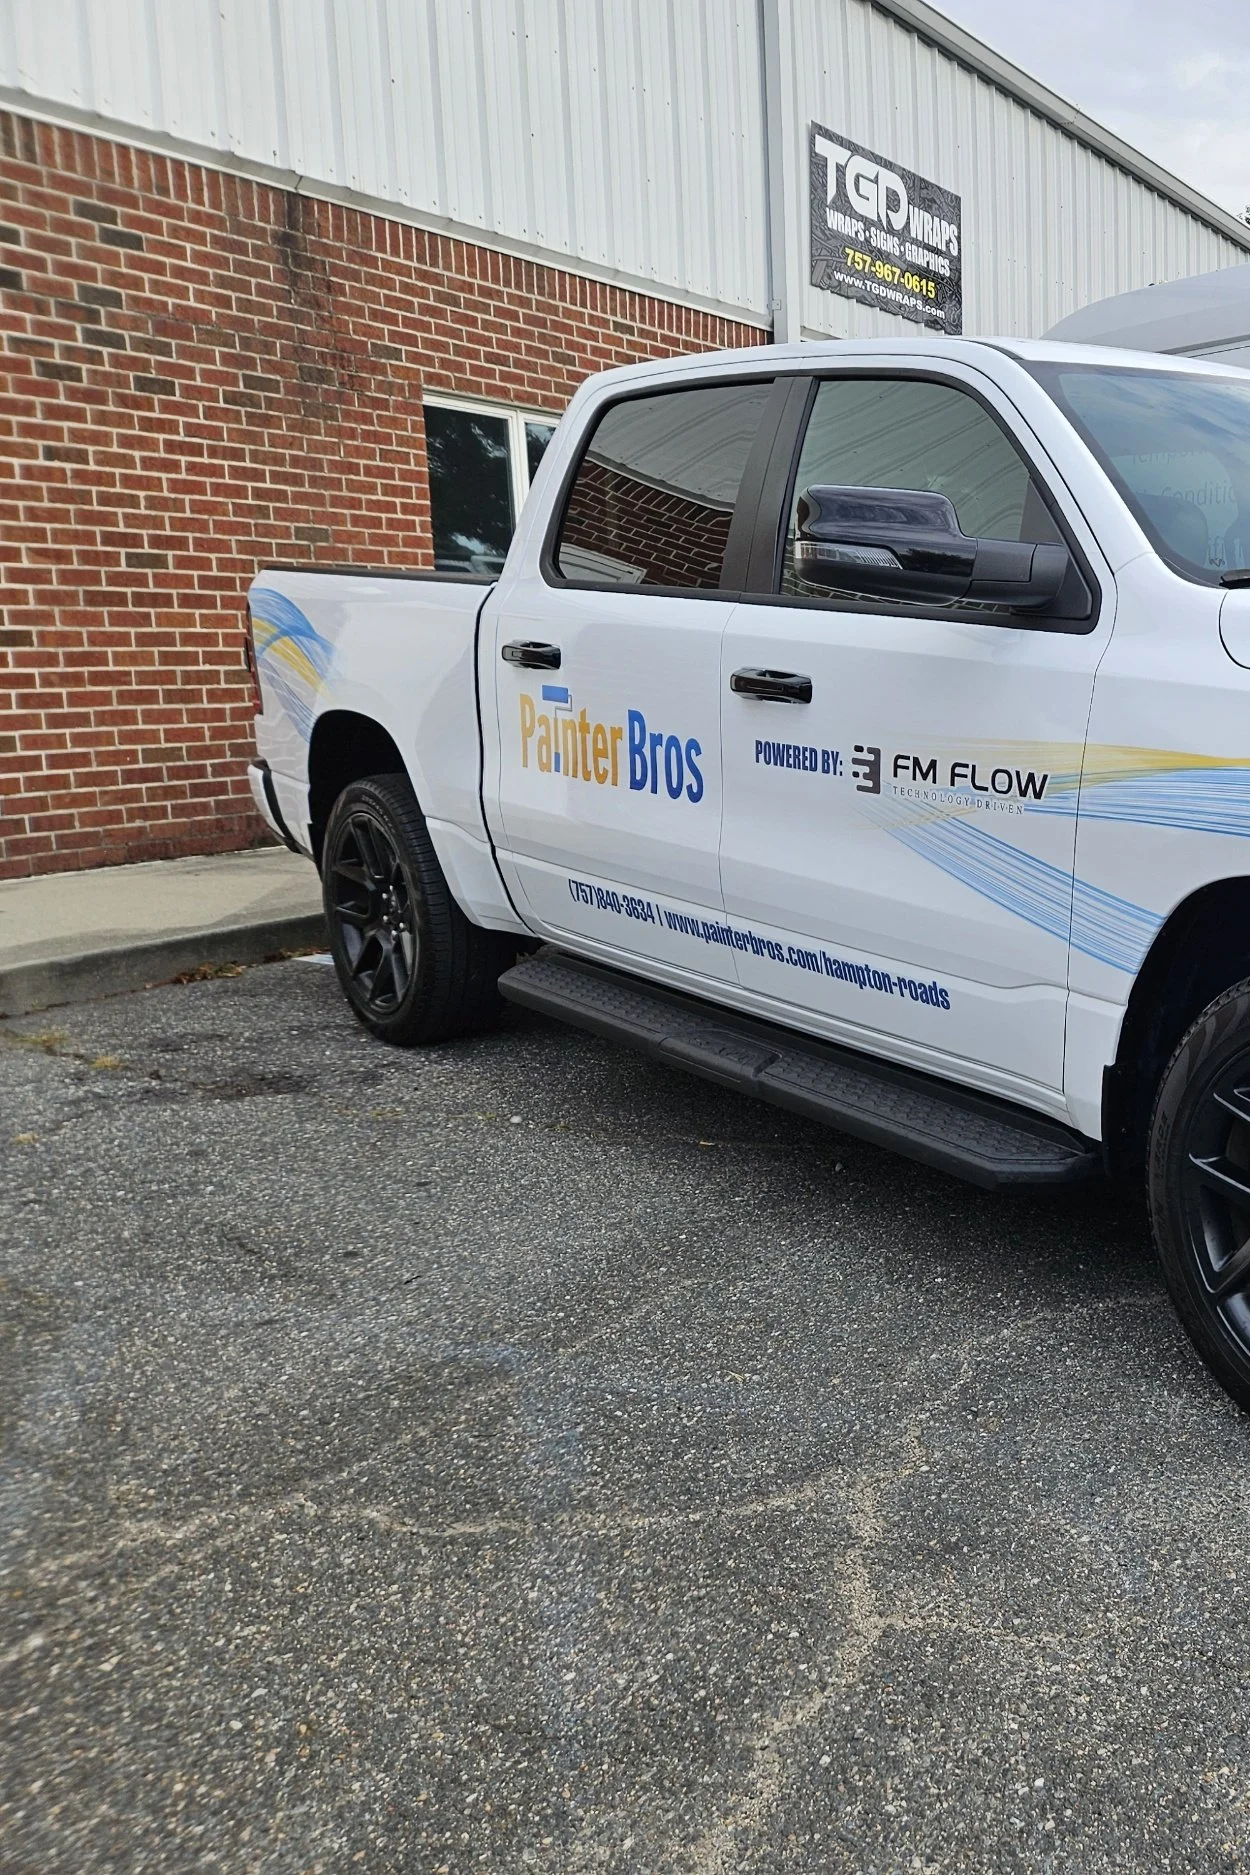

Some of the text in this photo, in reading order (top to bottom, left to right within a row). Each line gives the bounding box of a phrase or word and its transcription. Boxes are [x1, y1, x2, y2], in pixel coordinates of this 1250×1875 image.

[815, 134, 958, 257] TGD WRAPS
[826, 207, 950, 277] WRAPS SIGNS GRAPHICS
[833, 271, 946, 319] www.TGDWRAPS.com
[844, 247, 936, 299] 757-967-0615
[755, 739, 844, 777] POWERED BY:
[892, 753, 1049, 801] FM FLOW
[892, 785, 1024, 816] TECHNOLOGY DRIVEN
[567, 878, 655, 925] (757)840-3634
[663, 909, 952, 1011] www.painterbros.com/hampton-roads
